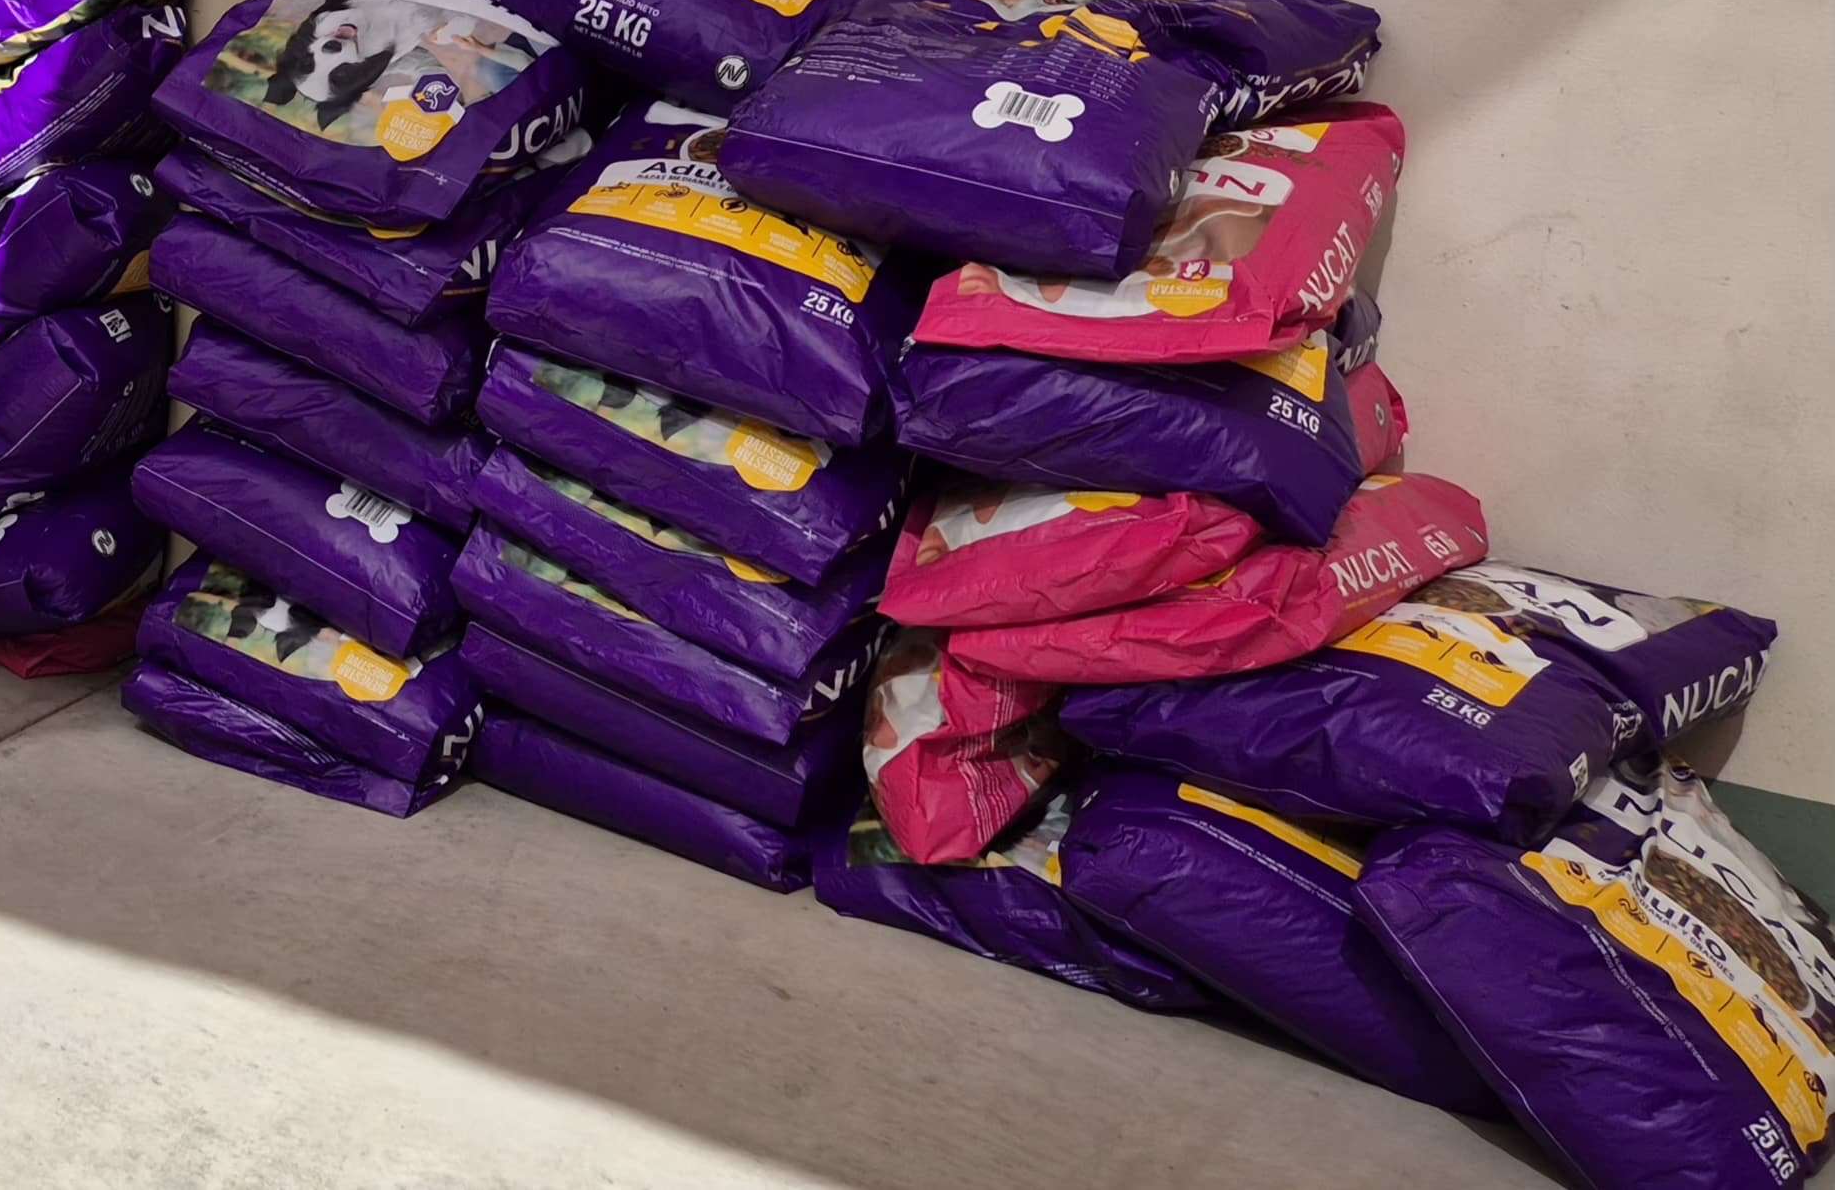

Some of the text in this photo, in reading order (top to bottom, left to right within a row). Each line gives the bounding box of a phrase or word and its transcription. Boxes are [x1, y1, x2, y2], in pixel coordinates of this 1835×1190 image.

[613, 8, 653, 49] KG
[636, 0, 660, 17] NETO
[489, 88, 584, 160] UCAN
[642, 160, 729, 183] Adu
[1297, 221, 1357, 315] NUCAT
[802, 291, 829, 312] 25
[831, 301, 855, 325] KG
[1270, 395, 1293, 419] 25
[1296, 407, 1321, 434] KG
[1329, 540, 1414, 598] NUCAT
[1426, 688, 1458, 709] 25
[1459, 702, 1491, 727] KG
[1604, 864, 1727, 961] Adulto
[1749, 1116, 1779, 1149] 25
[1769, 1145, 1795, 1181] KG
